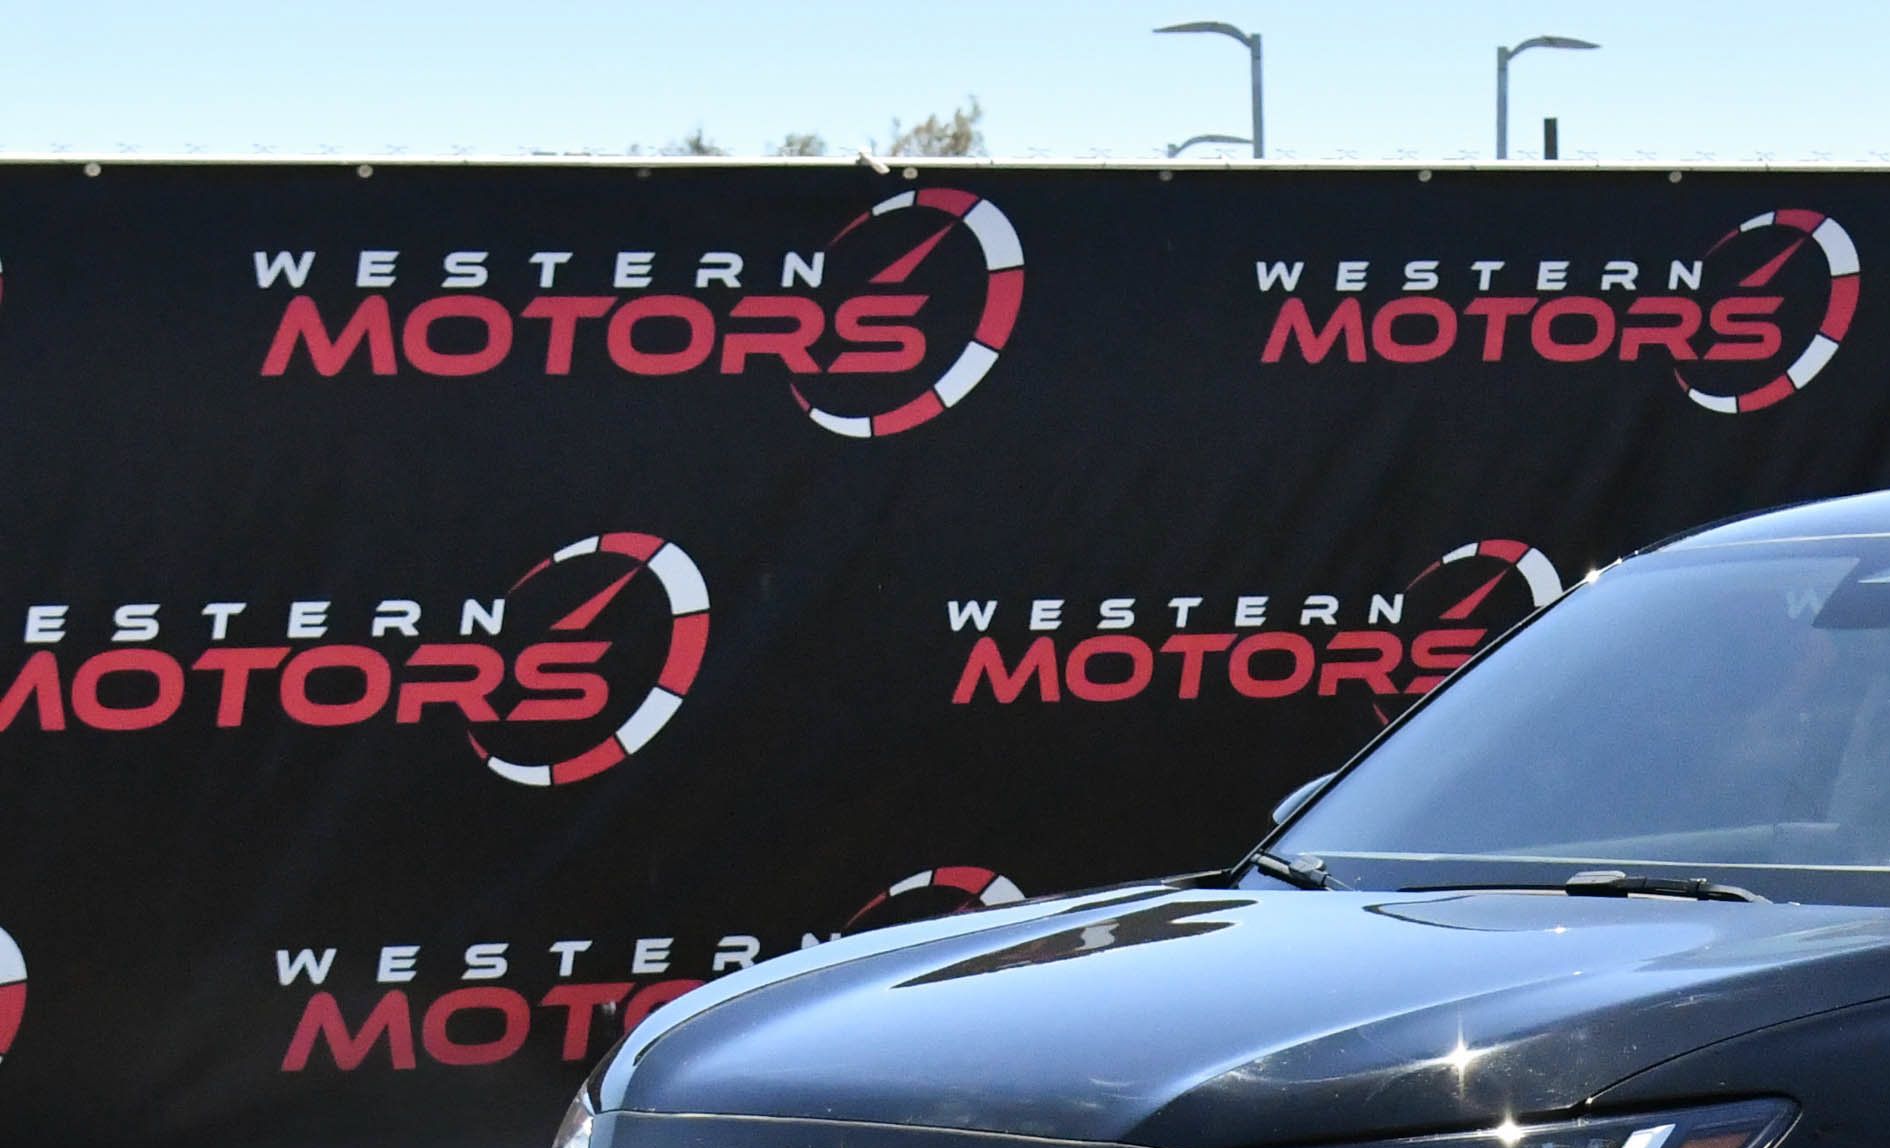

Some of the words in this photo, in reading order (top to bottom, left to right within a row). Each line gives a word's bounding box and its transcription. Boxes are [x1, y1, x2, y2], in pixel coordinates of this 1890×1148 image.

[254, 250, 826, 289] WESTERN
[1255, 259, 1704, 293] WESTERN
[260, 293, 930, 378] MOTORS
[1261, 294, 1785, 365] MOTORS
[947, 592, 1405, 633] WESTERN
